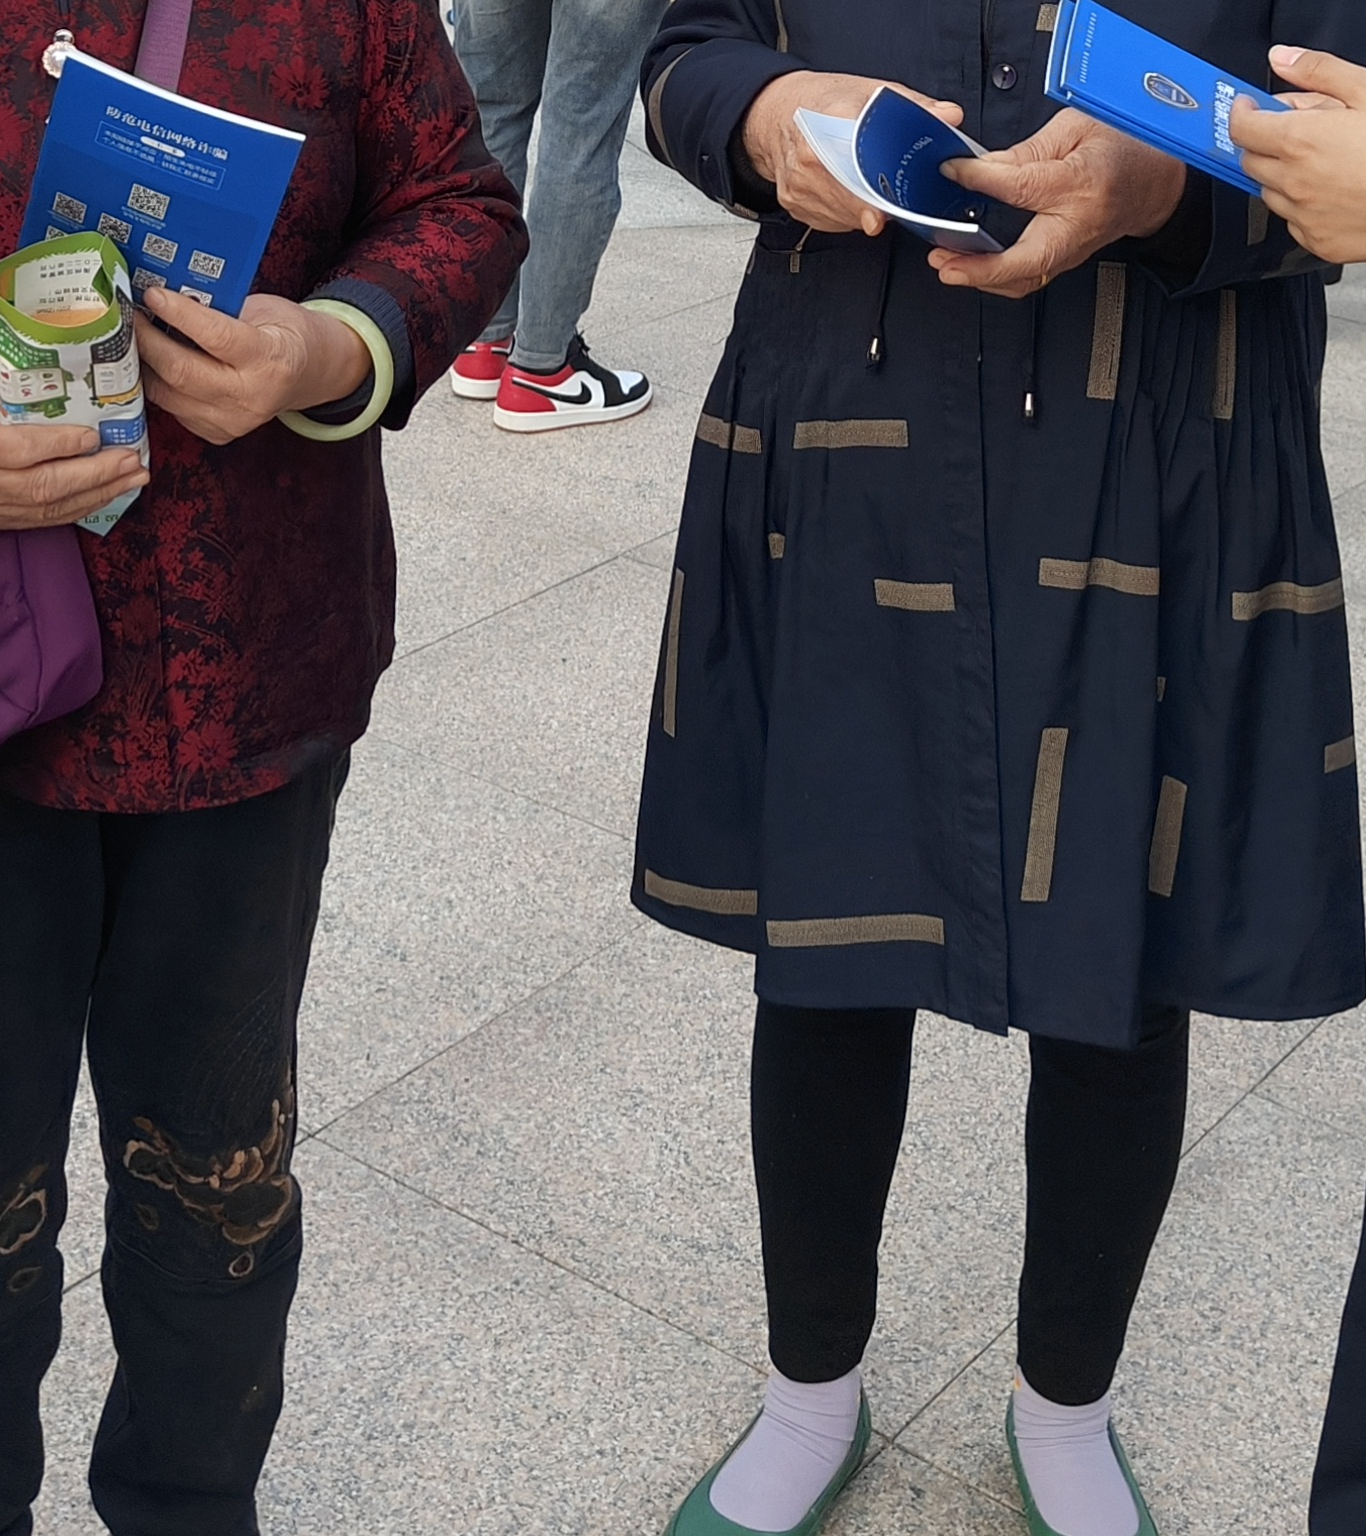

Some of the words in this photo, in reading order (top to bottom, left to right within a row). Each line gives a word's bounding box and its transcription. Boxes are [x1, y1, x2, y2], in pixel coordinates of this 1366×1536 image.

[105, 105, 229, 161] 防范电信网络诈骗
